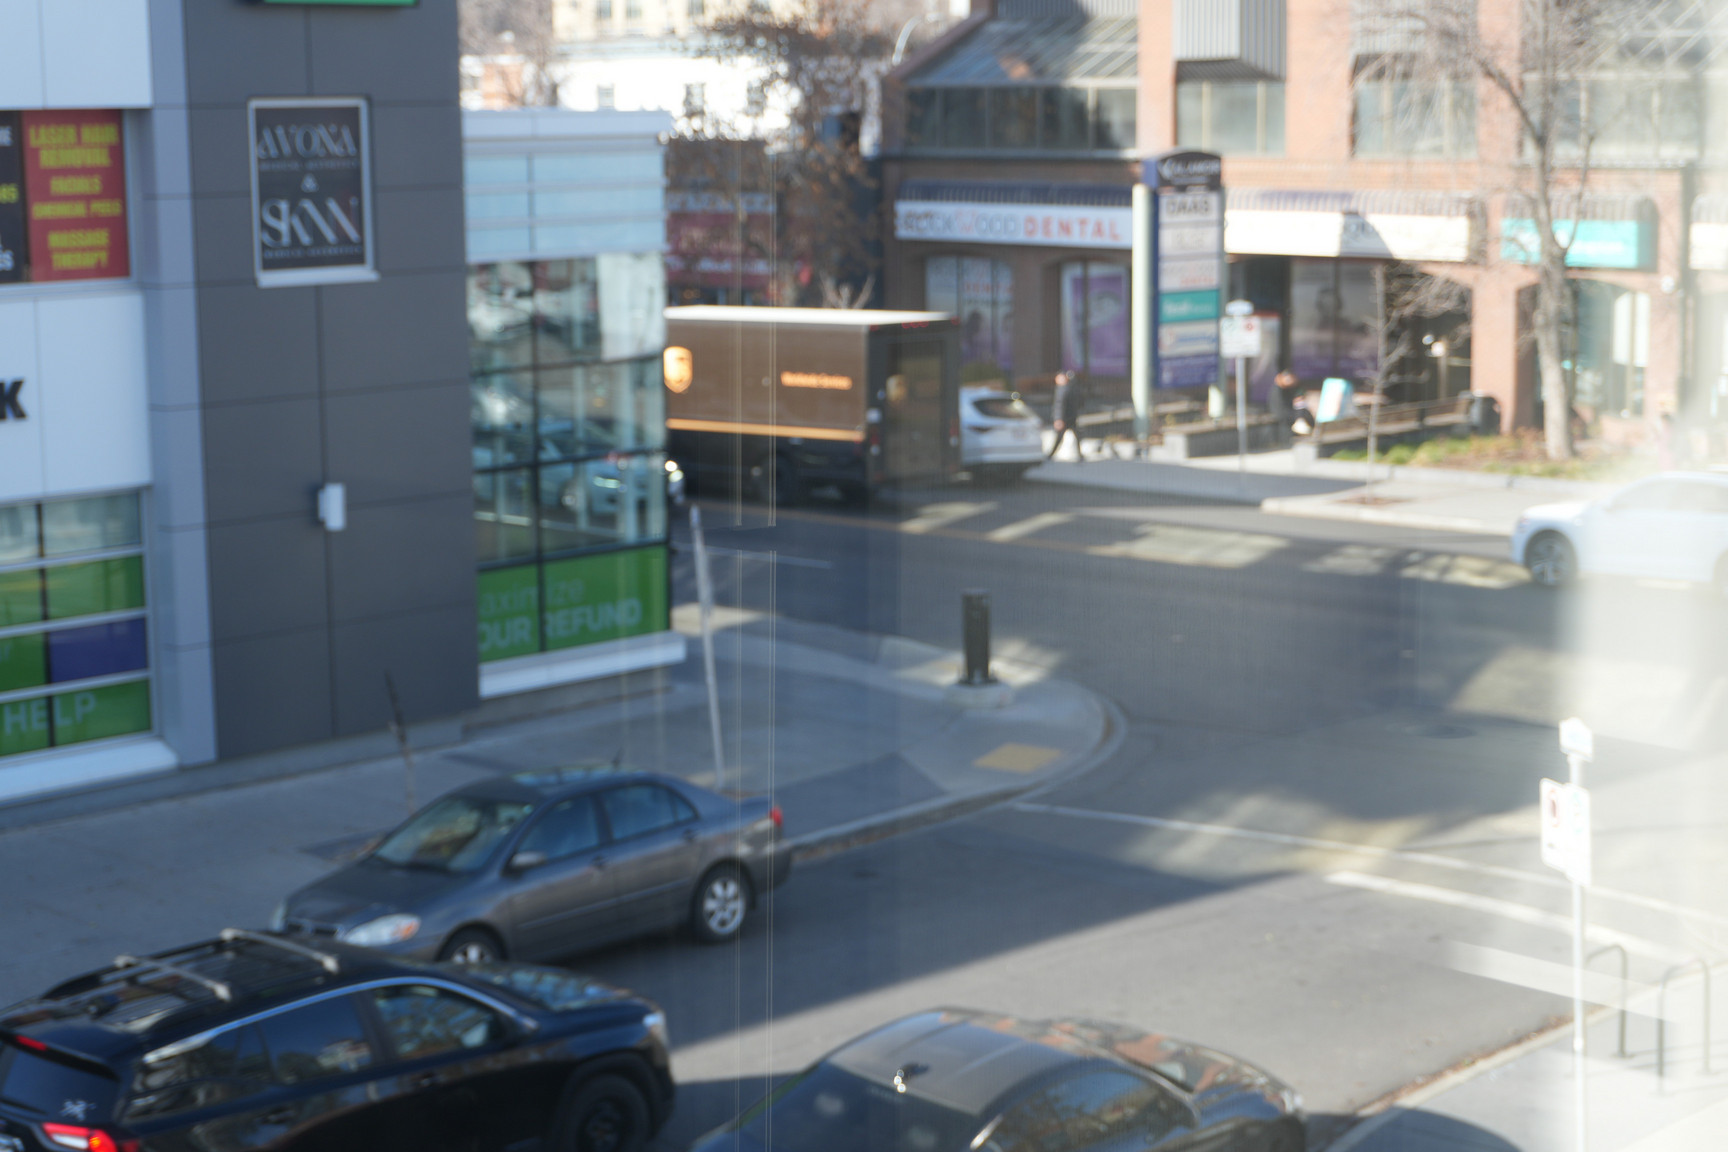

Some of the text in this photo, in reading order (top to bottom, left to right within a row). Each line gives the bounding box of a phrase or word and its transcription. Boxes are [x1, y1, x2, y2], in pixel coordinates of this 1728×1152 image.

[300, 173, 320, 193] &
[1023, 216, 1121, 240] DENTAL
[3, 692, 96, 736] HELP
